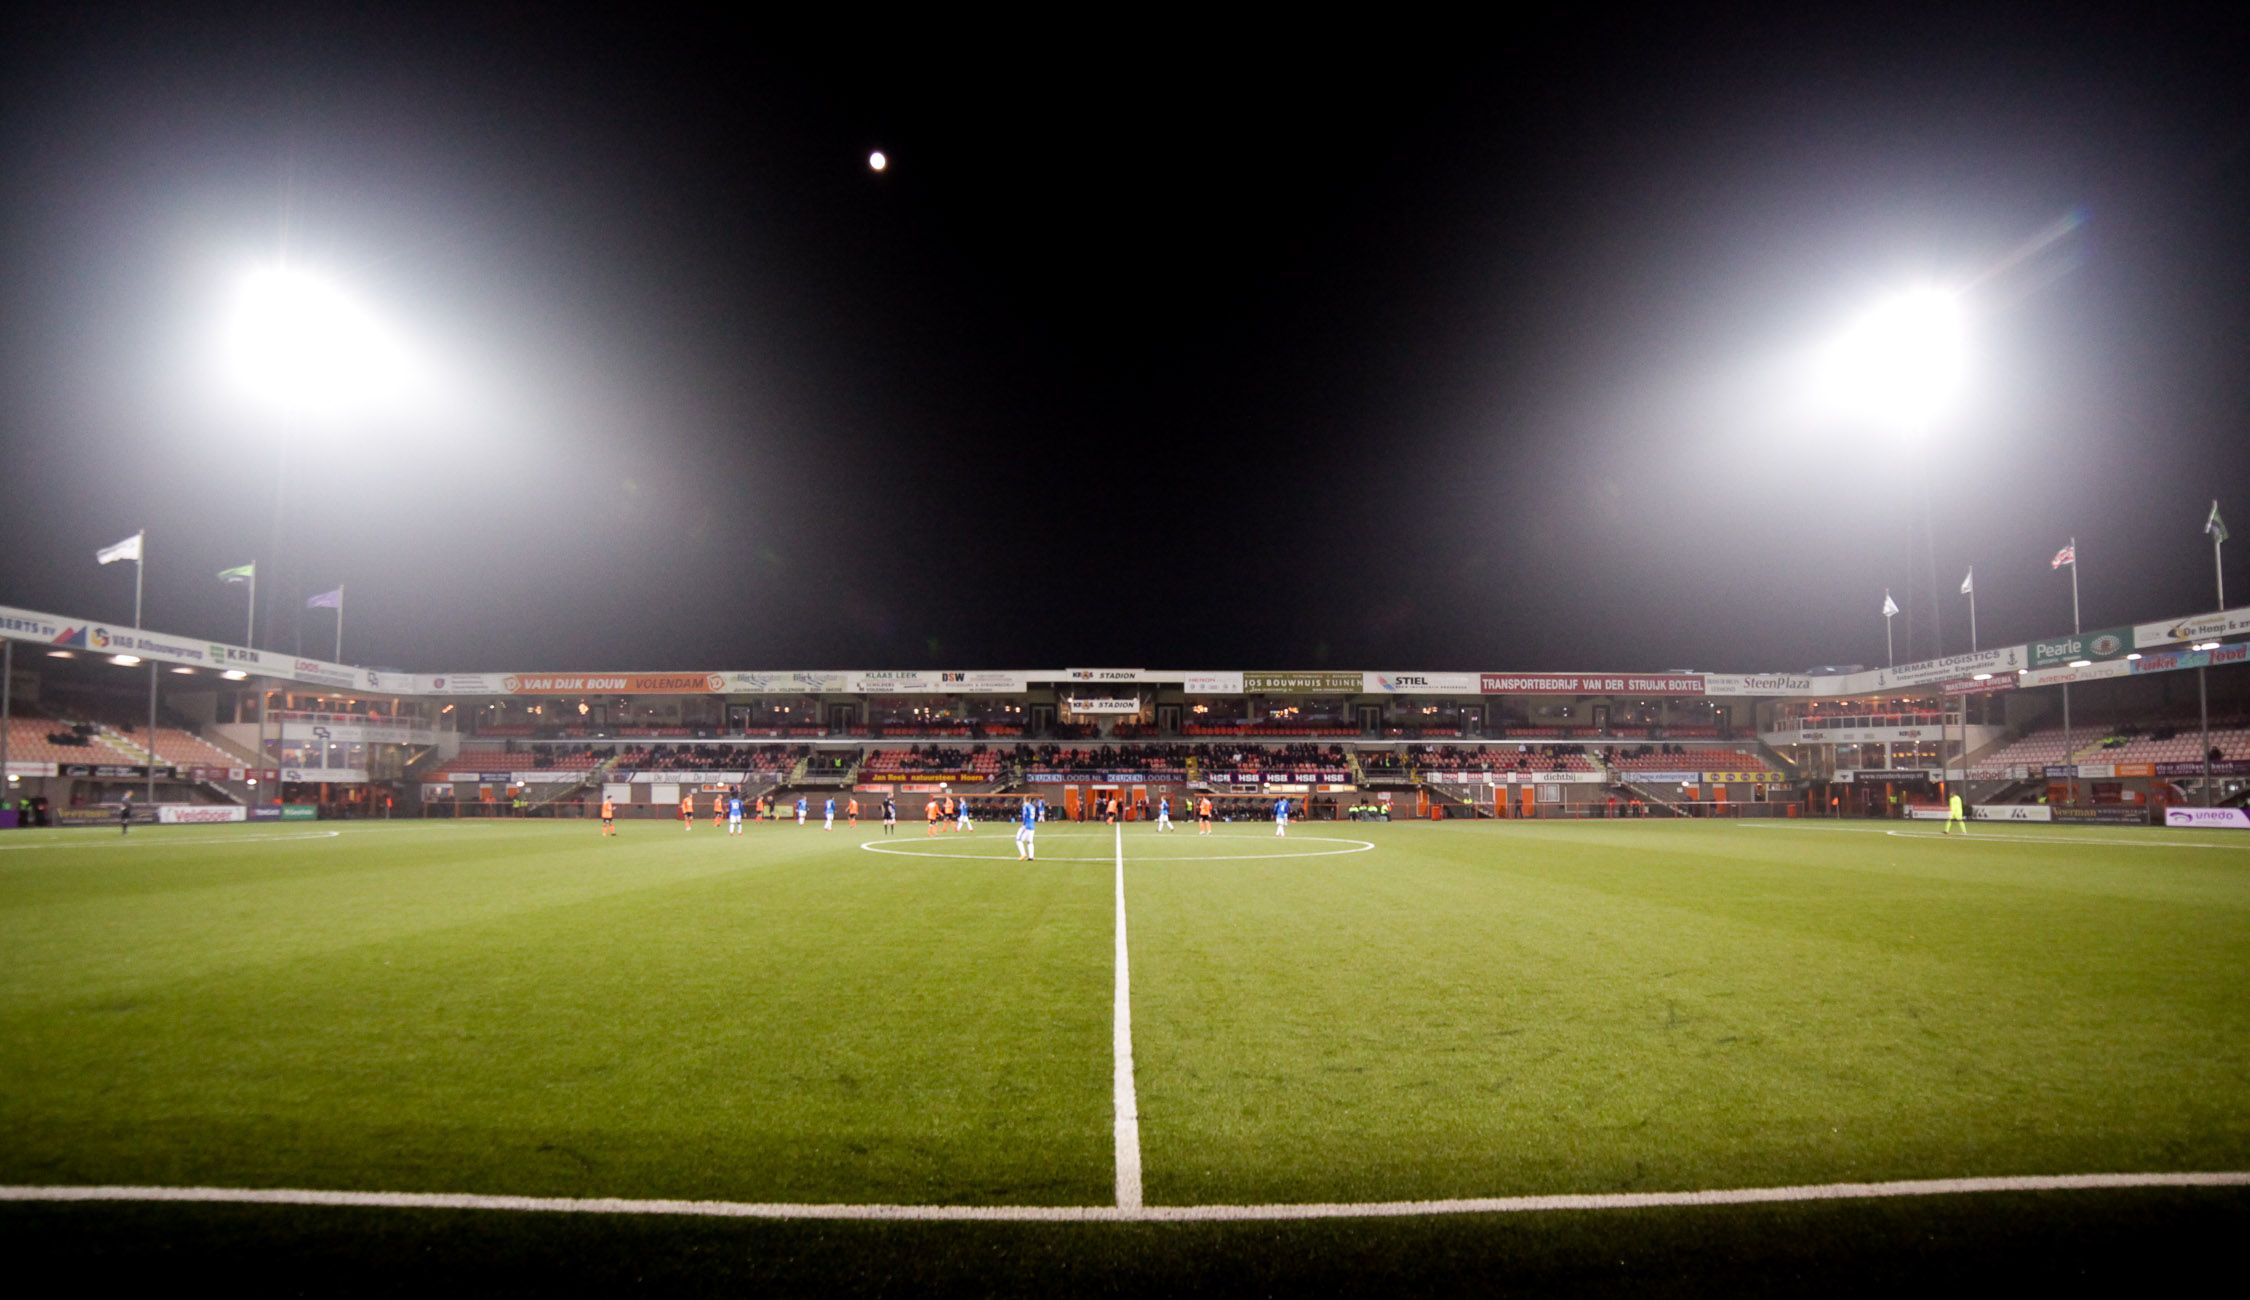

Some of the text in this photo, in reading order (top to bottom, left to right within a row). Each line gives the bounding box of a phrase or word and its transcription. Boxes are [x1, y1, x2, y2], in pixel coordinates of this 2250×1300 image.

[2036, 640, 2082, 659] Pearle
[227, 648, 260, 663] KRN
[1892, 650, 2001, 675] SERMAR LOGISTICS
[524, 678, 552, 690] VAN
[587, 678, 628, 690] BOUW
[635, 678, 704, 690] VOLENDAM
[1244, 679, 1262, 688] JOS
[1266, 679, 1321, 687] BOUWHUIS
[1325, 679, 1363, 687] TUINEN
[1395, 677, 1428, 685] STIEL
[1482, 678, 1579, 690] TRANSPORTBEDRIJF
[1583, 679, 1601, 690] VAN
[1605, 679, 1624, 690] DER
[1628, 679, 1667, 691] STRUIJK
[1668, 679, 1704, 691] BOXTEL
[1743, 677, 1810, 689] SteenPlaza
[1238, 774, 1260, 782] HSB
[1266, 774, 1288, 782] HSB
[1295, 774, 1317, 782] HSB
[1323, 774, 1345, 782] HSB
[2195, 809, 2234, 820] unedo
